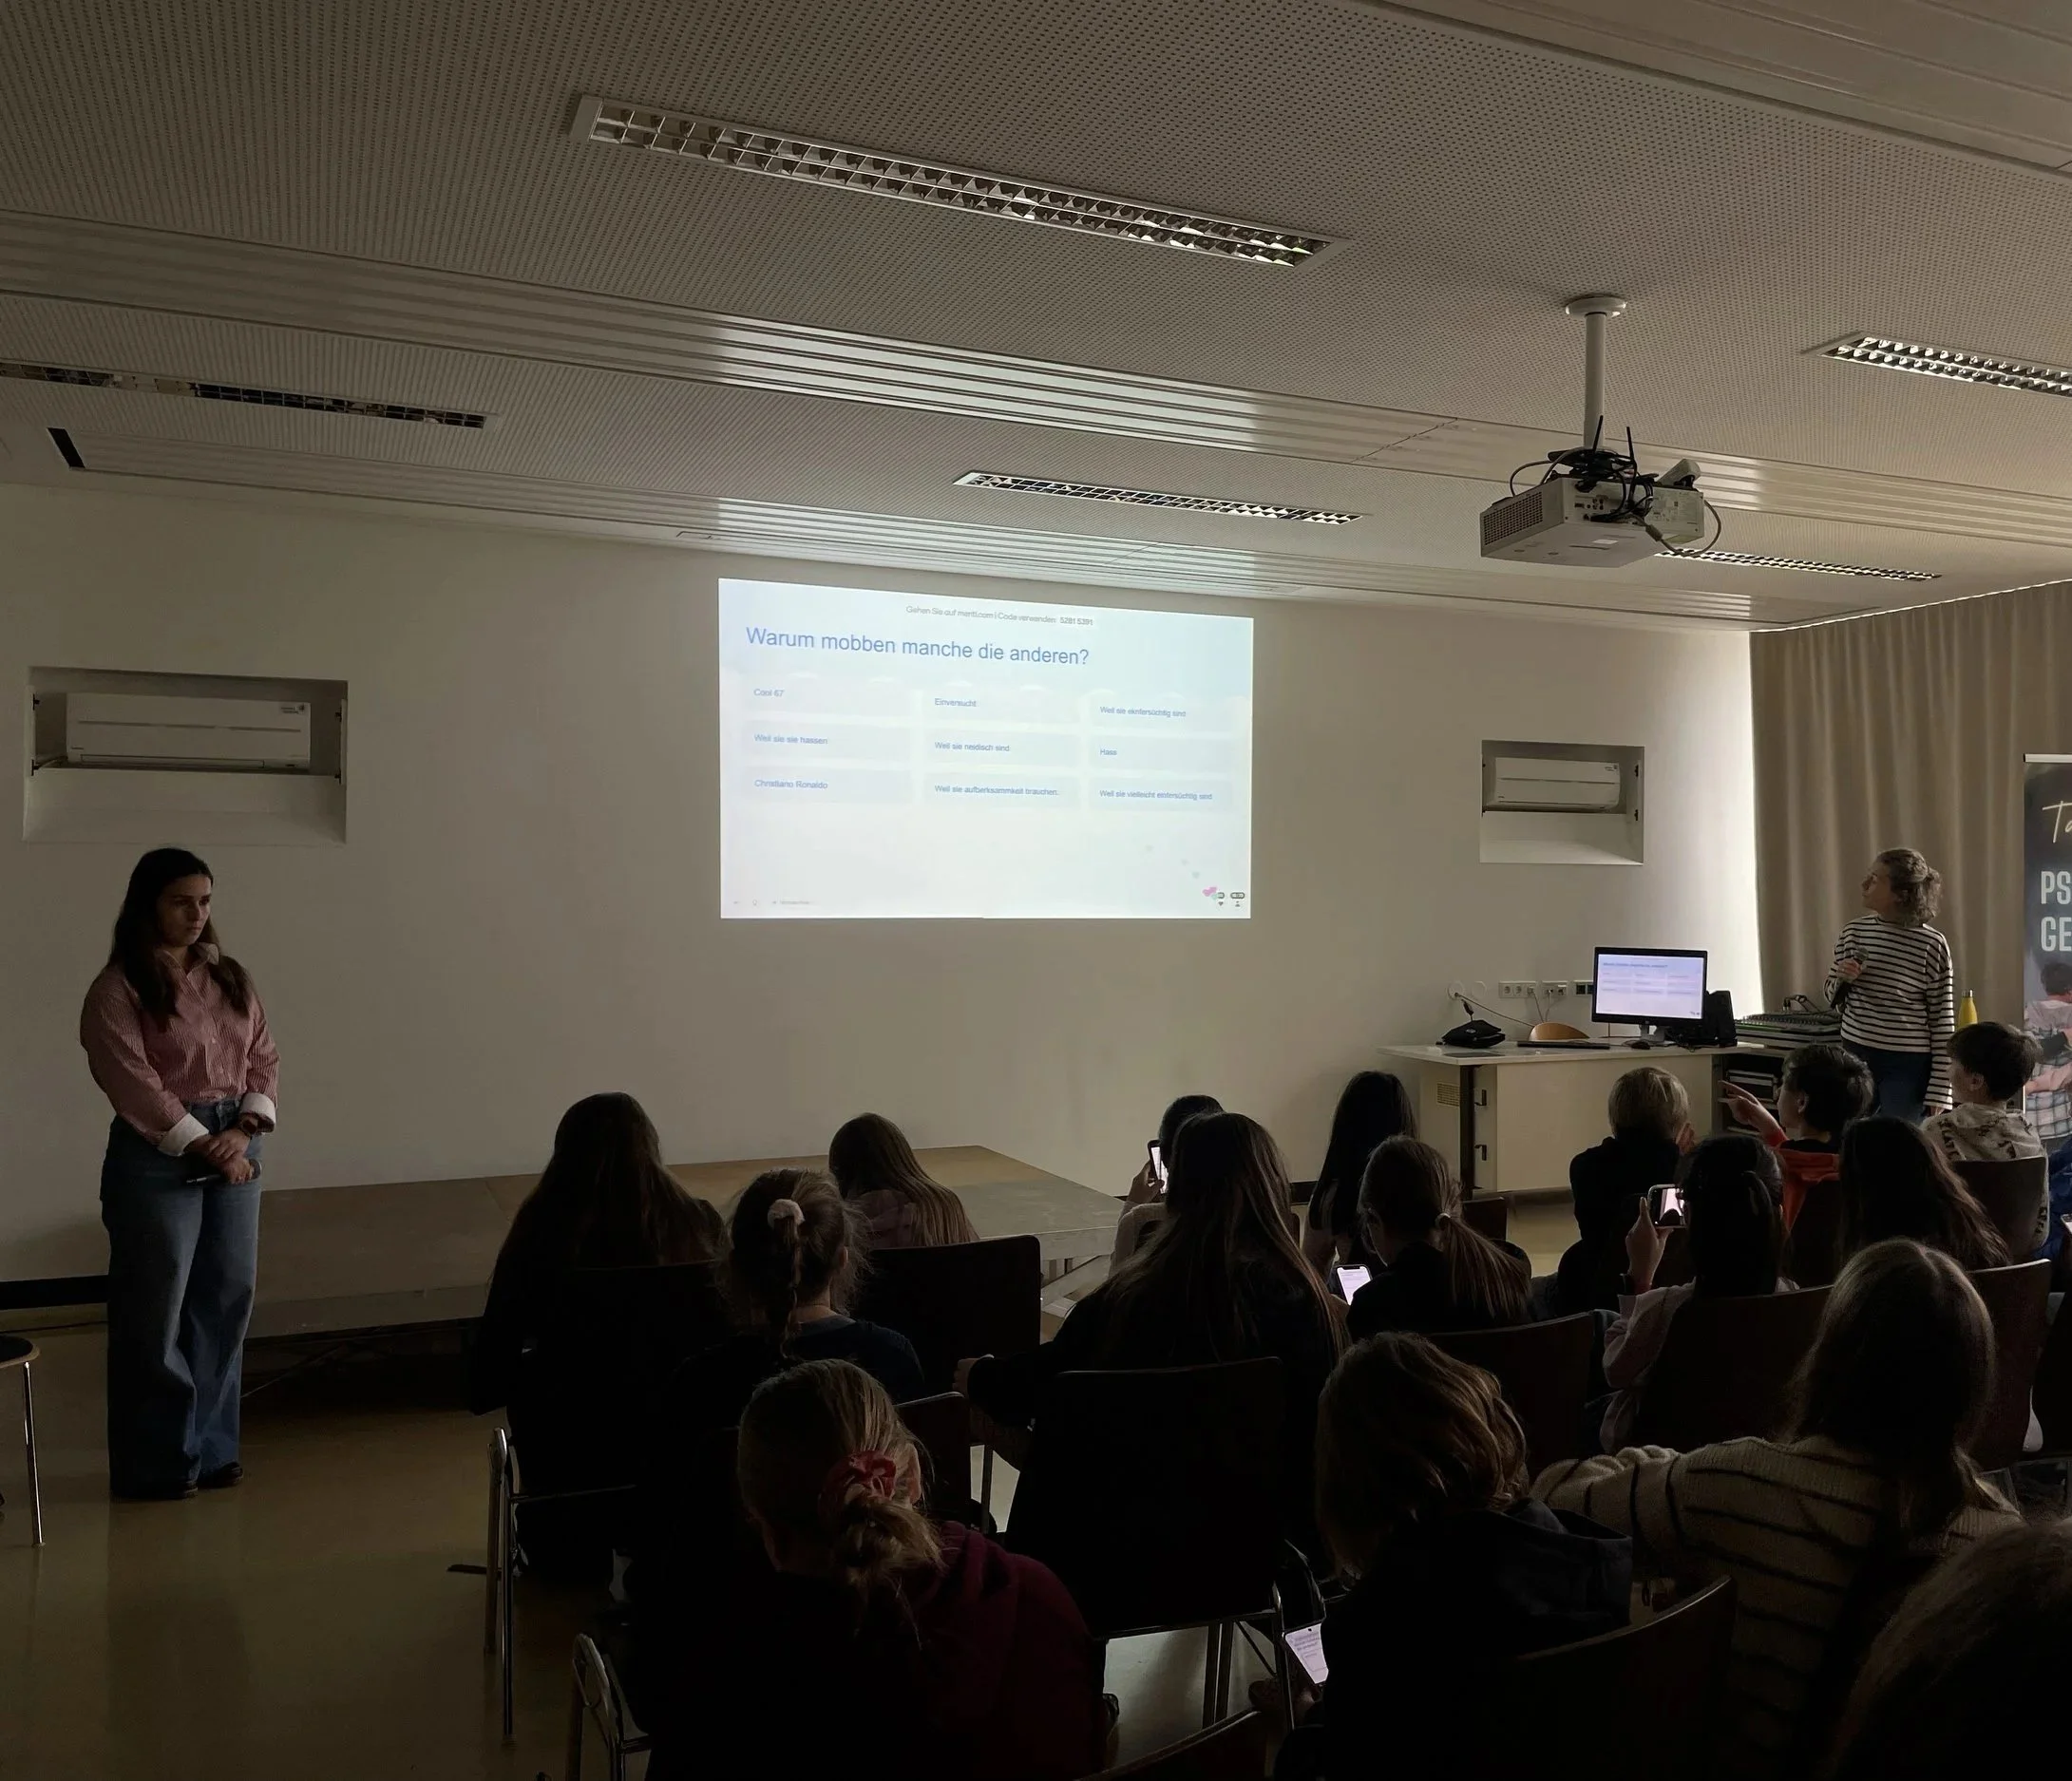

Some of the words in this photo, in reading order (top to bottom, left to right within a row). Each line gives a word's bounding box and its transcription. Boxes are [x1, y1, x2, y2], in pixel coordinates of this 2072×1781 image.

[905, 605, 931, 615] Gehen
[931, 607, 943, 616] Sie
[998, 612, 1017, 620] Code
[746, 626, 814, 648] Warum
[821, 634, 896, 654] mobben
[902, 640, 973, 658] manche
[979, 643, 1004, 660] die
[1009, 646, 1090, 665] anderen?
[1100, 706, 1114, 714] Weil
[754, 733, 771, 743] Weil
[773, 734, 785, 744] sie
[787, 734, 798, 744] sie
[800, 735, 828, 745] hassen
[935, 742, 950, 750] Weil
[952, 742, 963, 750] sie
[964, 742, 994, 751] neidisch
[995, 744, 1010, 752] sind
[795, 780, 828, 789] Ronaldo
[935, 785, 950, 793] Weil
[952, 785, 963, 793] sie
[1099, 789, 1114, 798] Weil
[2041, 870, 2072, 904] PS
